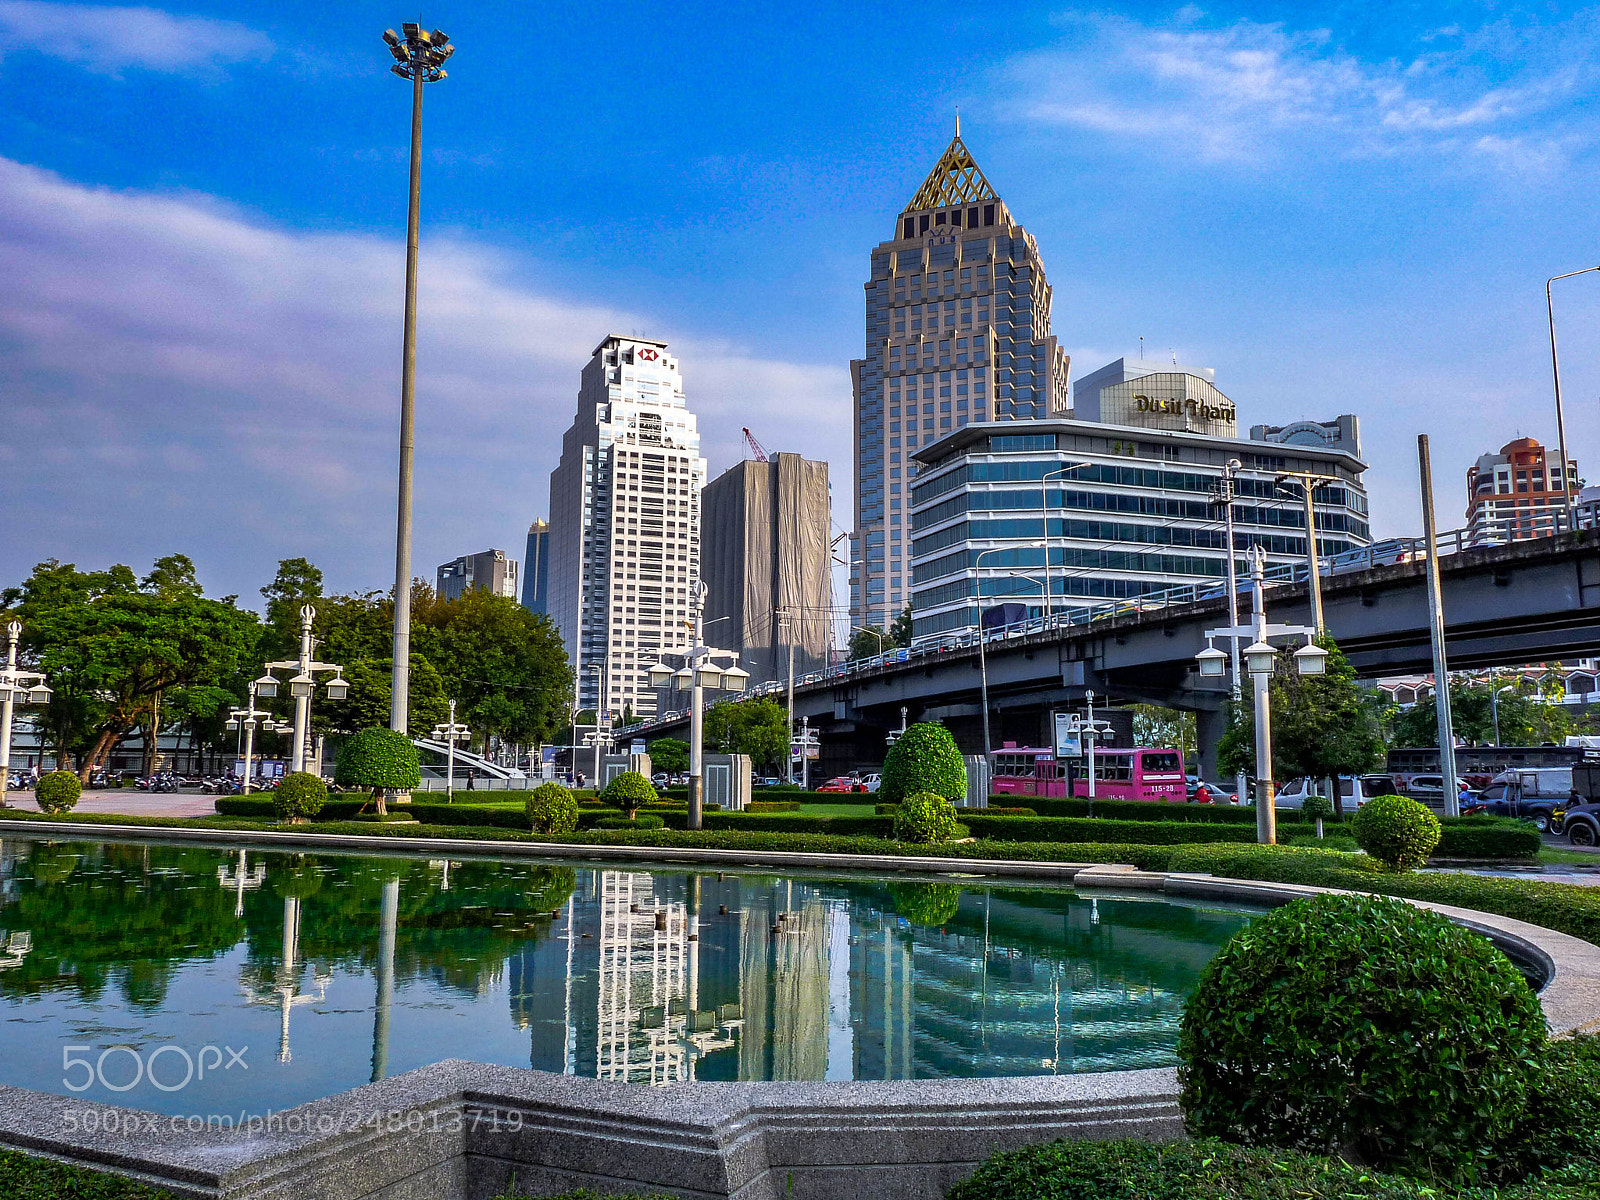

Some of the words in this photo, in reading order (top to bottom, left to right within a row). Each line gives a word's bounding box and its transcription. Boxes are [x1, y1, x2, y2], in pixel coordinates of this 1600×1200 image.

[1133, 391, 1184, 416] Dusit
[1185, 398, 1236, 424] Thani
[495, 550, 504, 561] So
